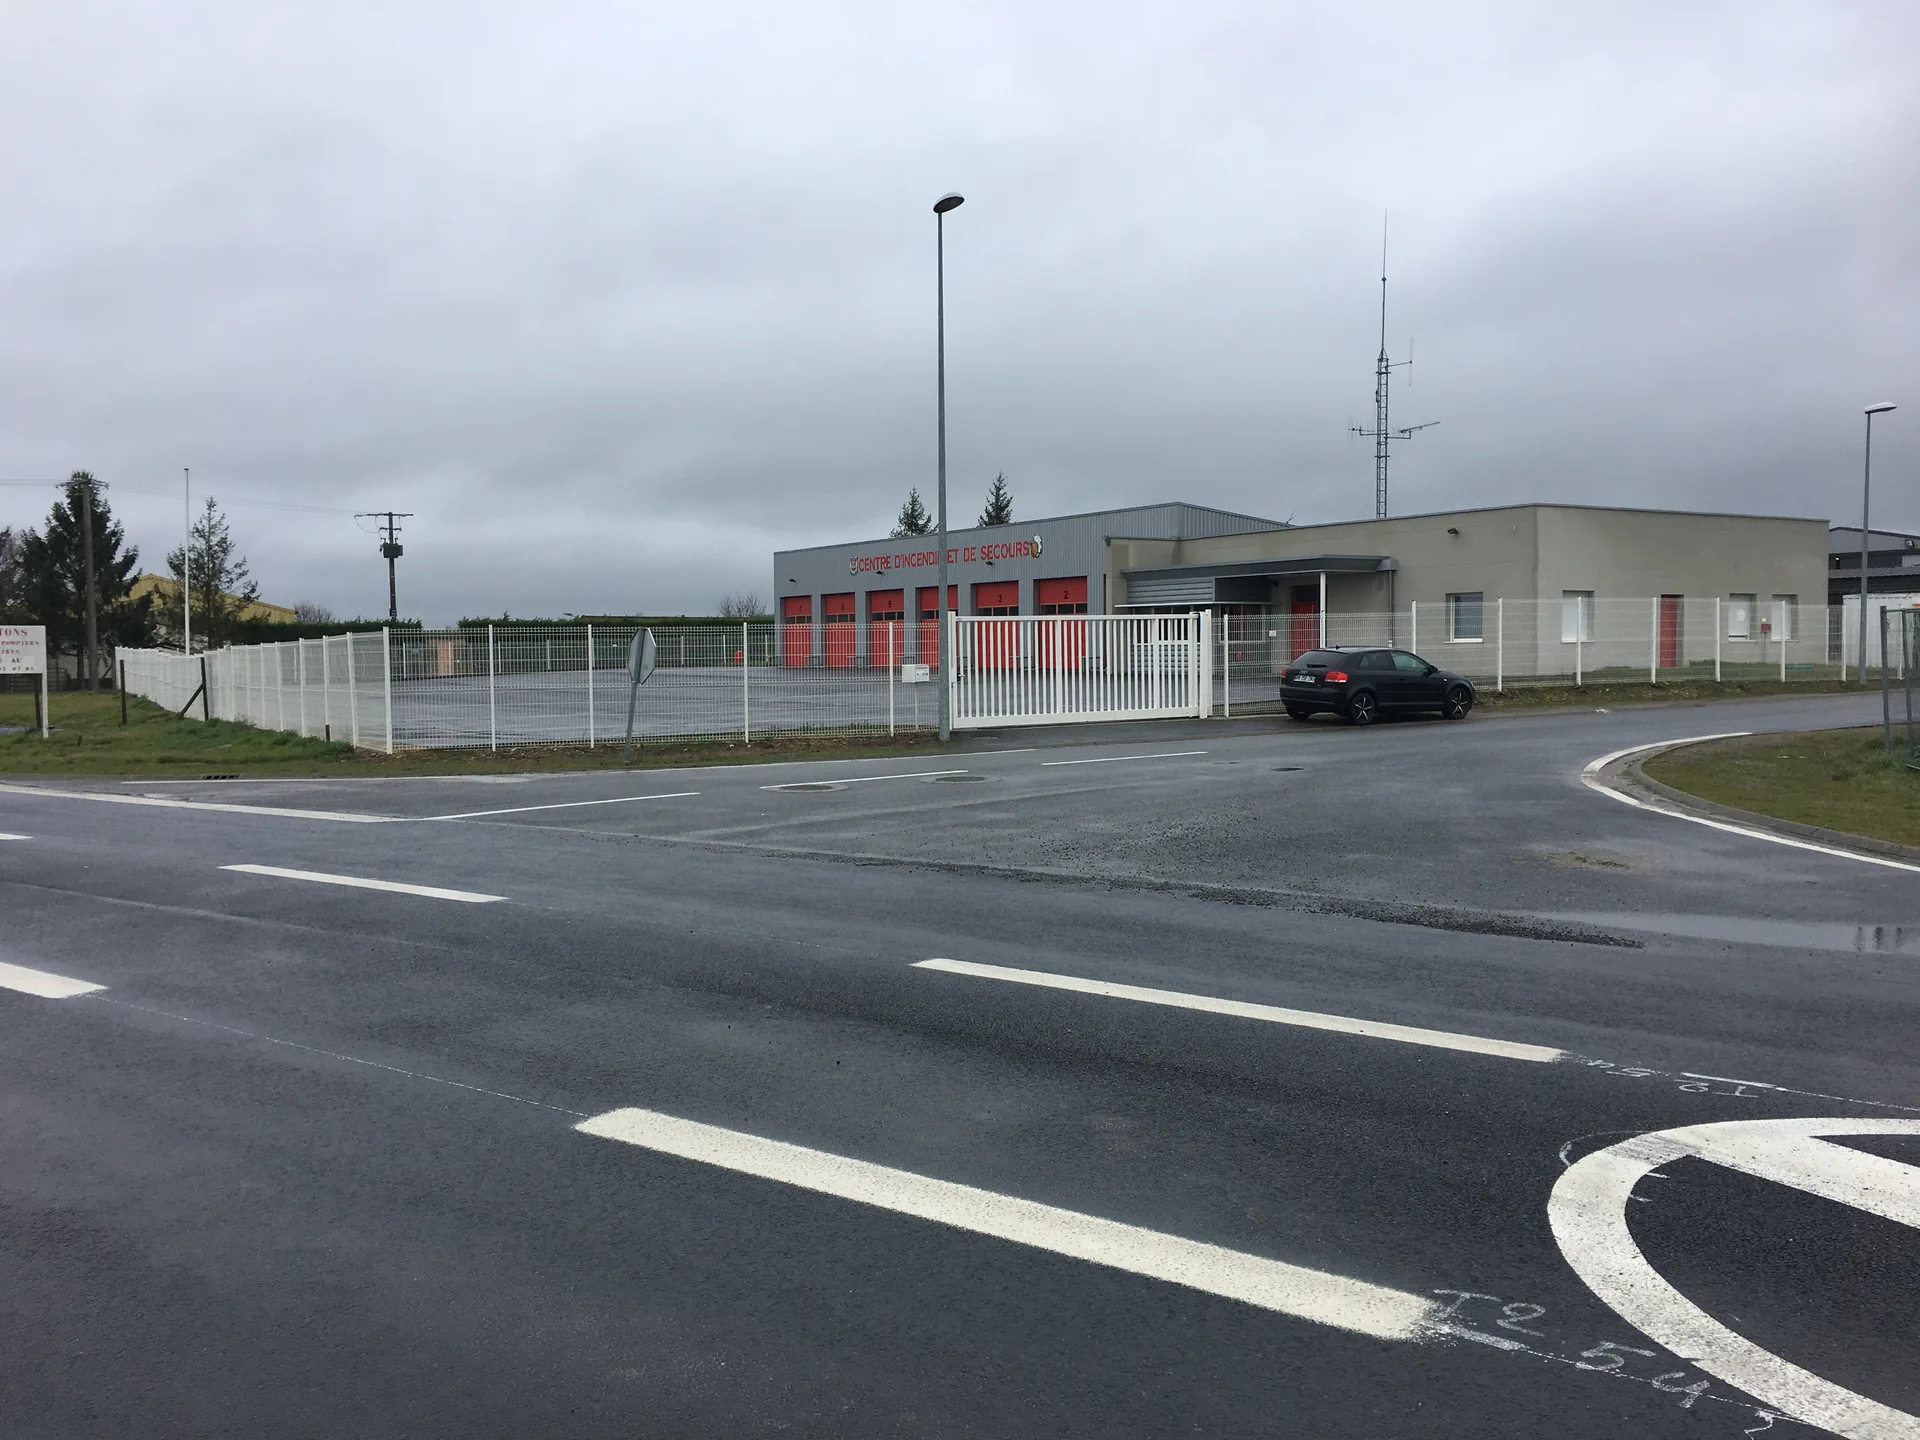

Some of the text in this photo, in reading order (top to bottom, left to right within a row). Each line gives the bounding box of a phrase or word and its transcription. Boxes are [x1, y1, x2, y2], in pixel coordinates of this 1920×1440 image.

[859, 555, 892, 572] CENTRE
[947, 548, 959, 565] ET
[963, 546, 977, 562] DE
[980, 540, 1030, 561] SECOURS
